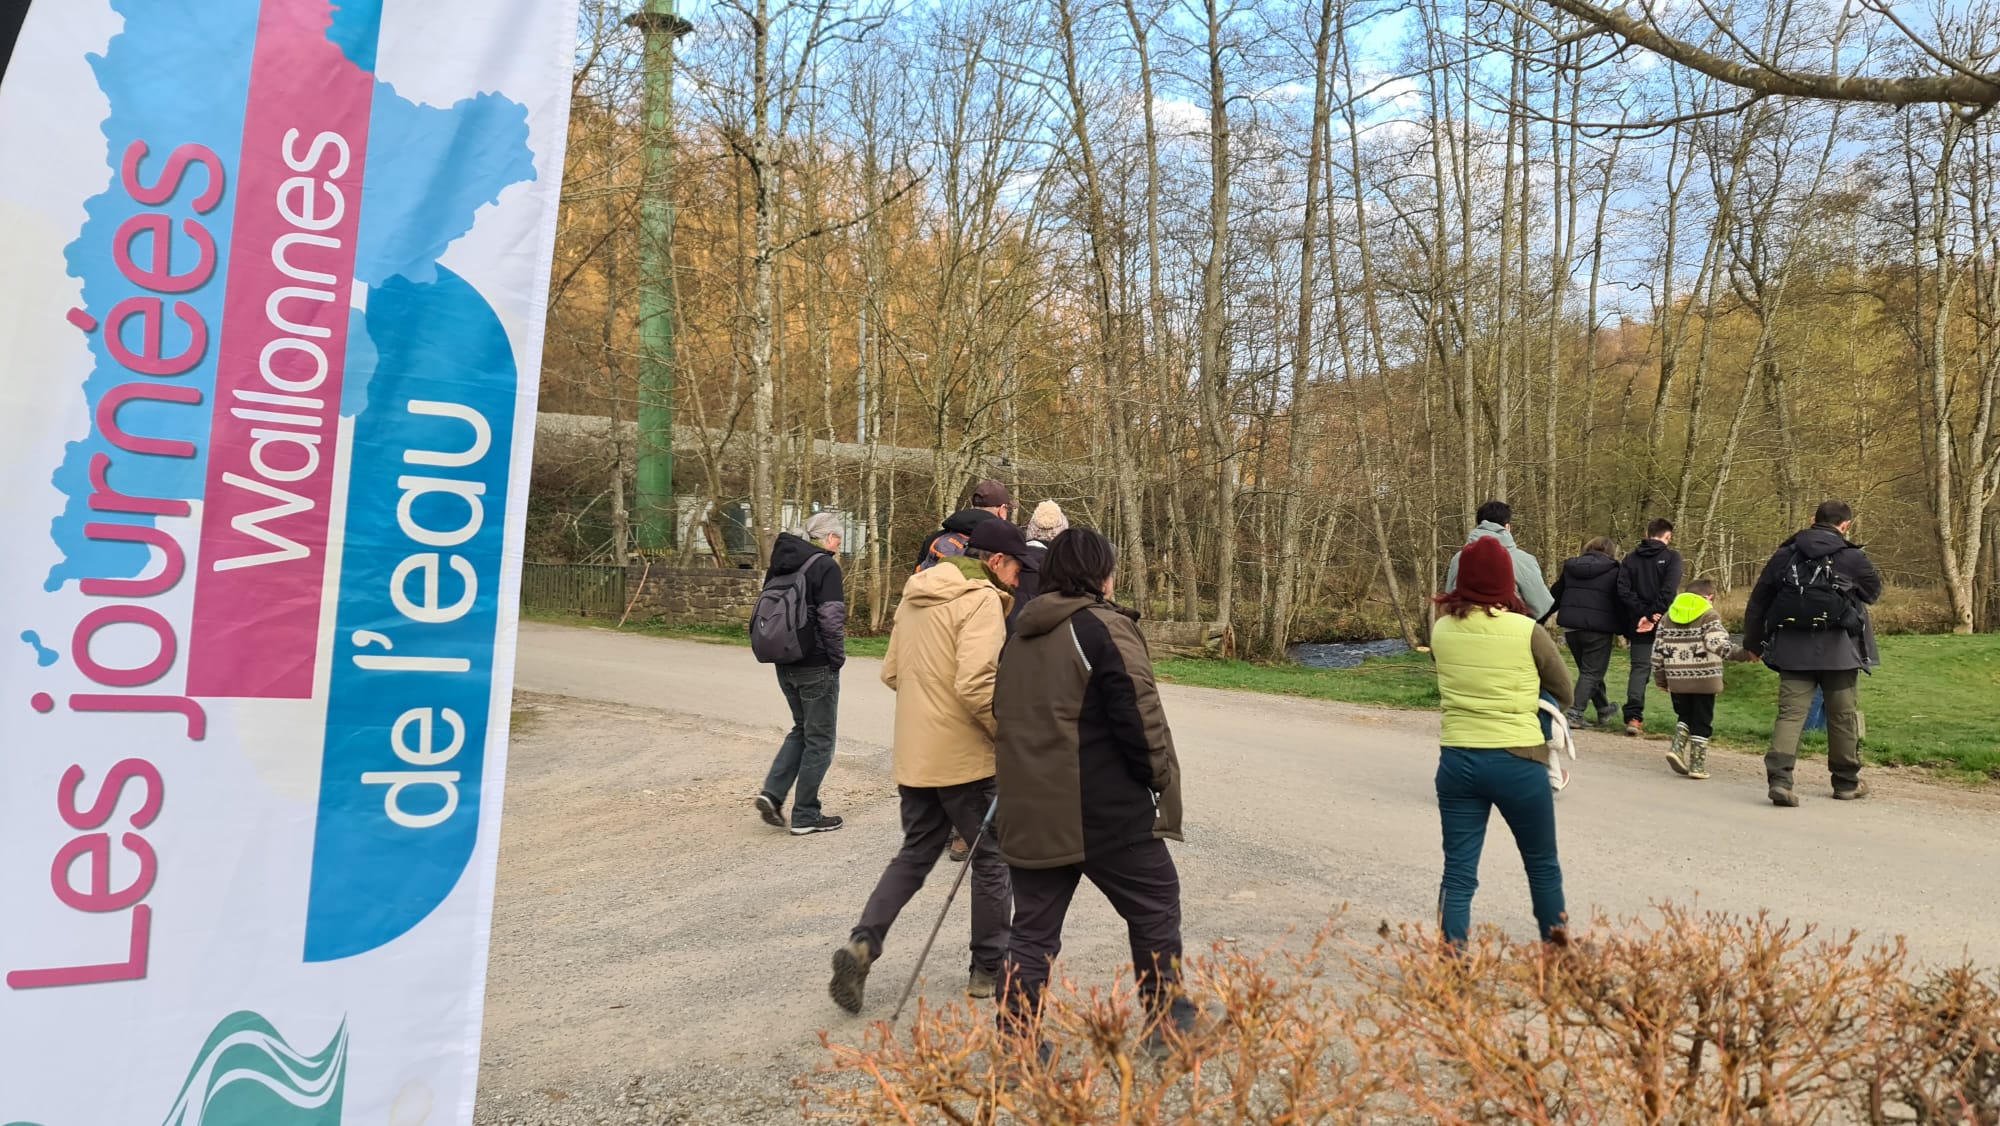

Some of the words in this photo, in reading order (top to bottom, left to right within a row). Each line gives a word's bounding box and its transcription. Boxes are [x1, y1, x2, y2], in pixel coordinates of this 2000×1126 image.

[30, 139, 226, 742] journées
[213, 128, 351, 572] Wallonnes
[351, 399, 493, 673] l'eau
[6, 757, 164, 990] Les
[361, 706, 466, 829] de
